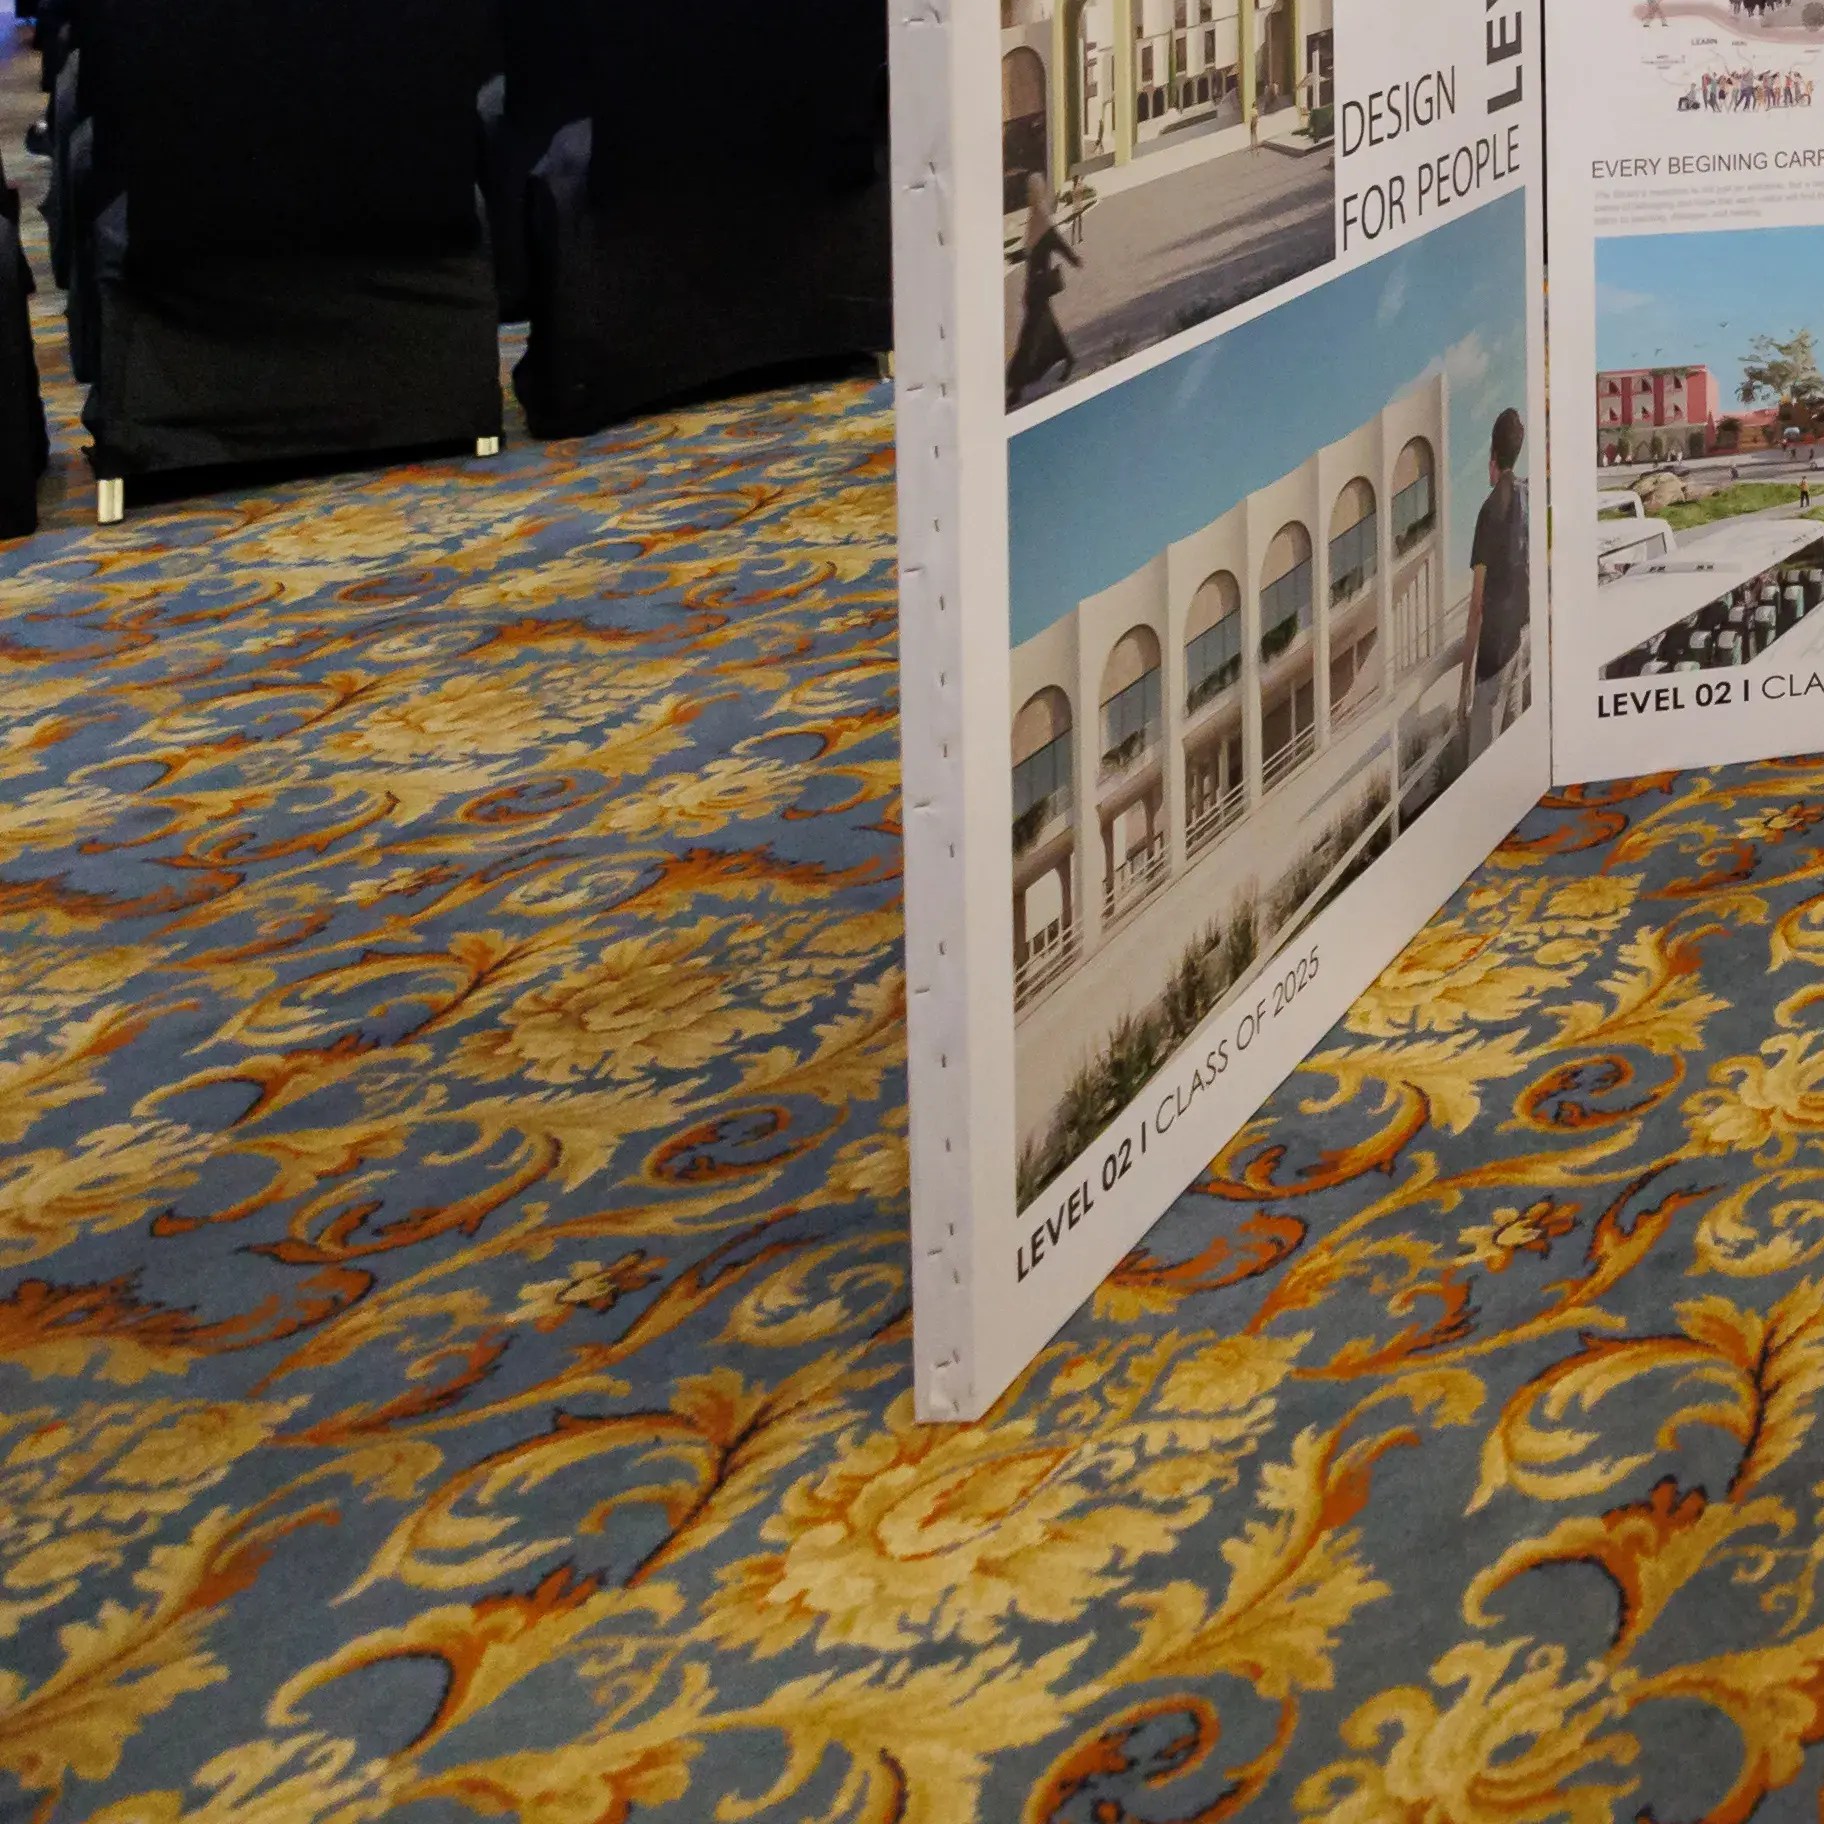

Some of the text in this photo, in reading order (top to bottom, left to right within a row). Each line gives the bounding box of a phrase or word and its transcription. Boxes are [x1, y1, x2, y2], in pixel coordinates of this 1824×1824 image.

[1341, 65, 1457, 158] DESIGN
[1343, 174, 1406, 251] FOR
[1417, 123, 1521, 217] PEOPLE
[1592, 157, 1660, 179] EVERY
[1668, 152, 1768, 175] BEGINING
[1597, 686, 1685, 718] LEVEL
[1695, 679, 1733, 708] 02
[1017, 1180, 1095, 1283] LEVEL
[1101, 1138, 1133, 1192] 02
[1155, 1039, 1229, 1134] CLASS
[1236, 1000, 1267, 1050] OF
[1273, 945, 1320, 1018] 2025
